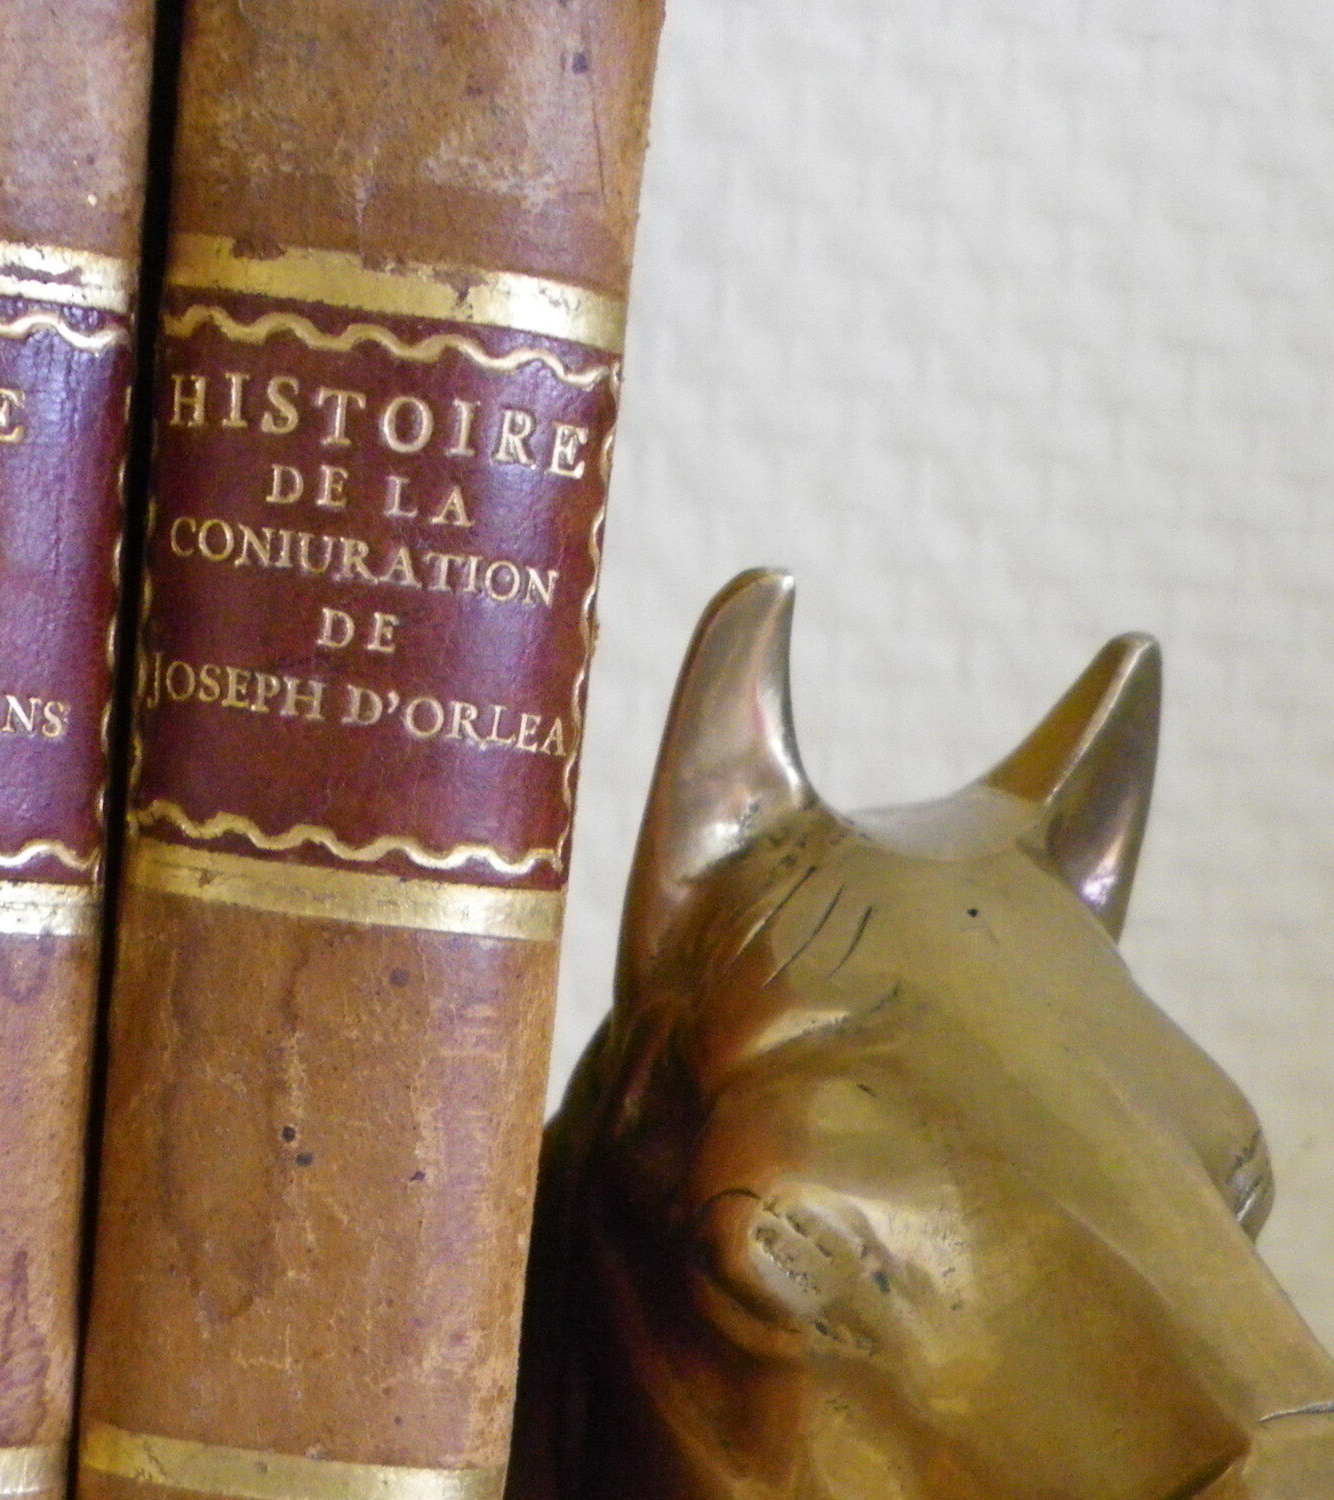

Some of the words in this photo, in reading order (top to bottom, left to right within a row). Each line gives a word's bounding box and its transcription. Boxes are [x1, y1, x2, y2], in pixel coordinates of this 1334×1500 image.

[170, 373, 588, 479] HISTOIRE
[265, 464, 349, 510] DE
[386, 475, 475, 527] LA
[170, 516, 560, 609] CONIURATION
[317, 607, 400, 654] DE
[146, 652, 327, 721] JOSEPH
